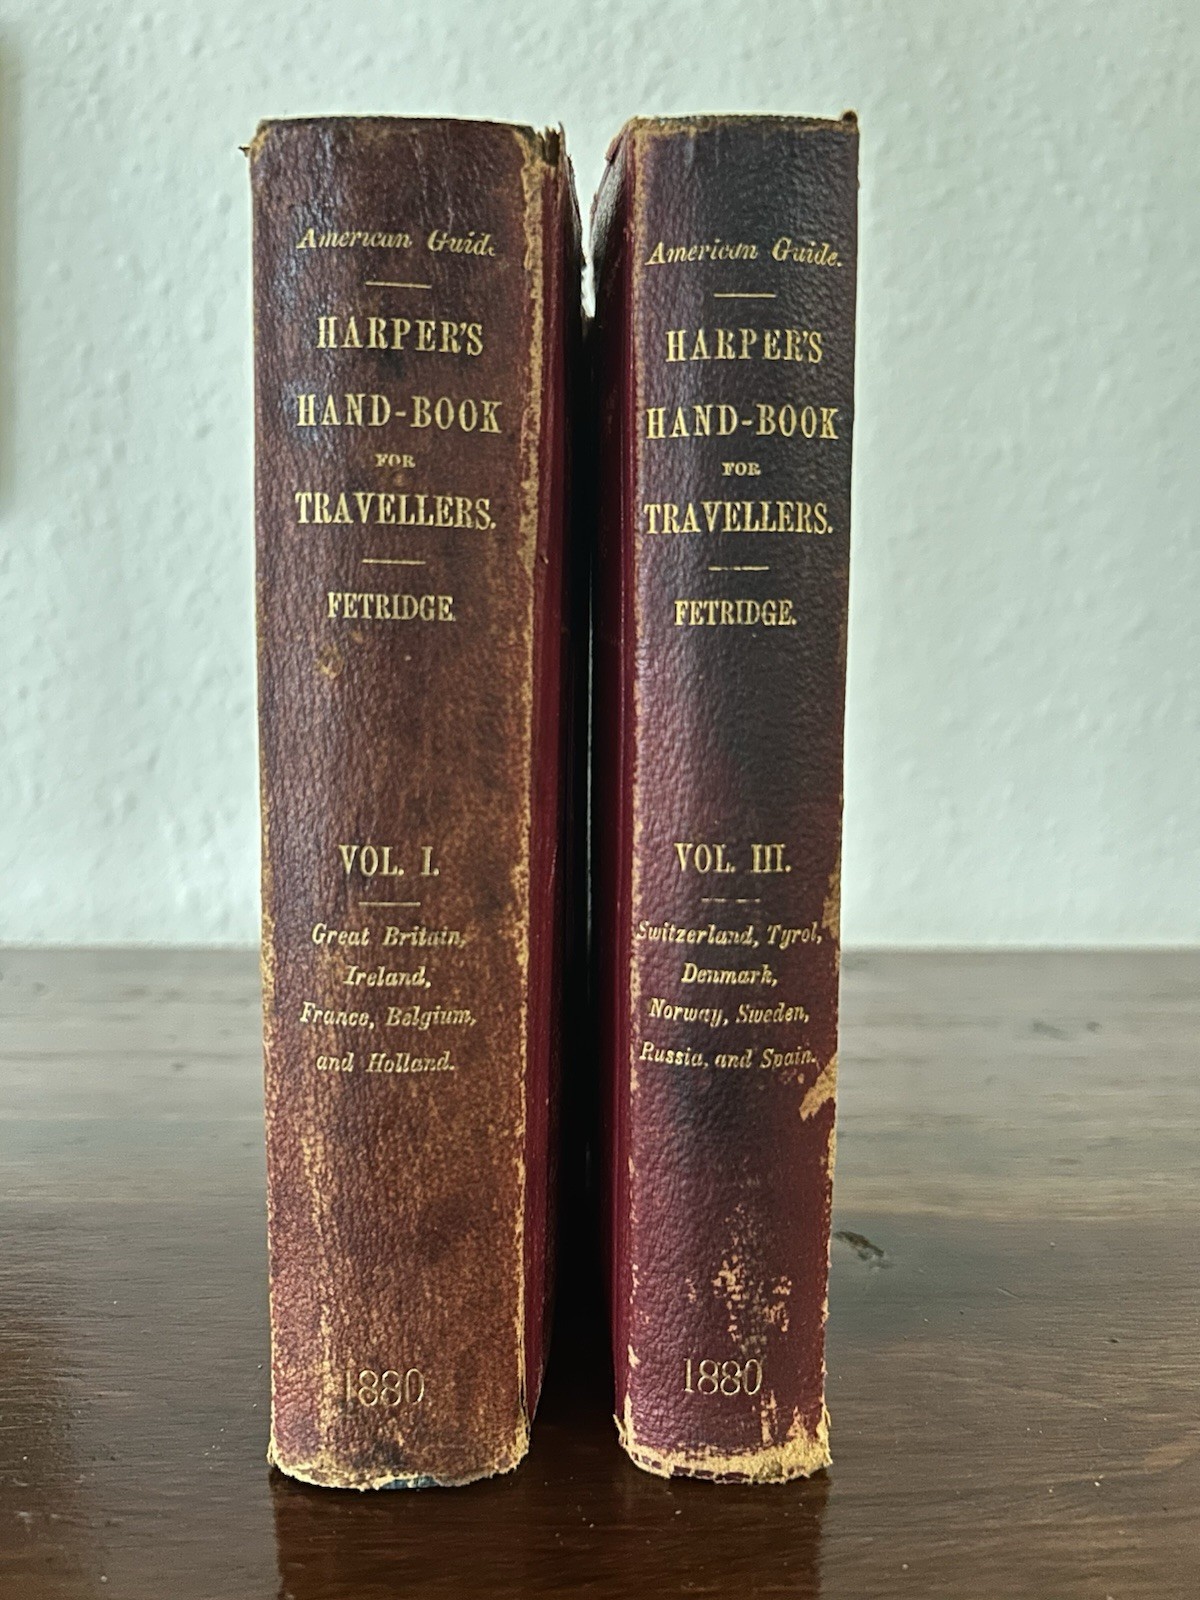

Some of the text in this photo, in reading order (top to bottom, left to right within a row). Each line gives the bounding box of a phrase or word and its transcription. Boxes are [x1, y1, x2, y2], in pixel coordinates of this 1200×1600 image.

[296, 228, 412, 250] American
[645, 236, 843, 267] American Guide.
[316, 316, 484, 356] HARPER'S
[665, 328, 823, 364] HARPER'S
[297, 393, 502, 433] HAND-BOOK
[646, 403, 839, 439] HAND-BOOK
[375, 453, 415, 469] FOR
[721, 462, 761, 476] FOR
[295, 491, 497, 530] TRAVELLERS.
[643, 501, 834, 535] TRAVELLERS.
[674, 600, 798, 626] FETRIDGE.
[338, 844, 440, 877] VOL. I.
[674, 842, 792, 874] VOL. III.
[311, 922, 467, 949] Great Britain,
[634, 920, 823, 950] Switzerland, Tyrol,
[342, 965, 432, 989] Ireland,
[680, 962, 779, 988] Denmark,
[300, 1001, 477, 1031] France, Belgium,
[649, 997, 811, 1028] Norway, Sweden,
[316, 1051, 456, 1073] and Holland.
[639, 1041, 709, 1068] Russia,
[714, 1050, 753, 1069] and
[682, 1358, 764, 1396] 1880
